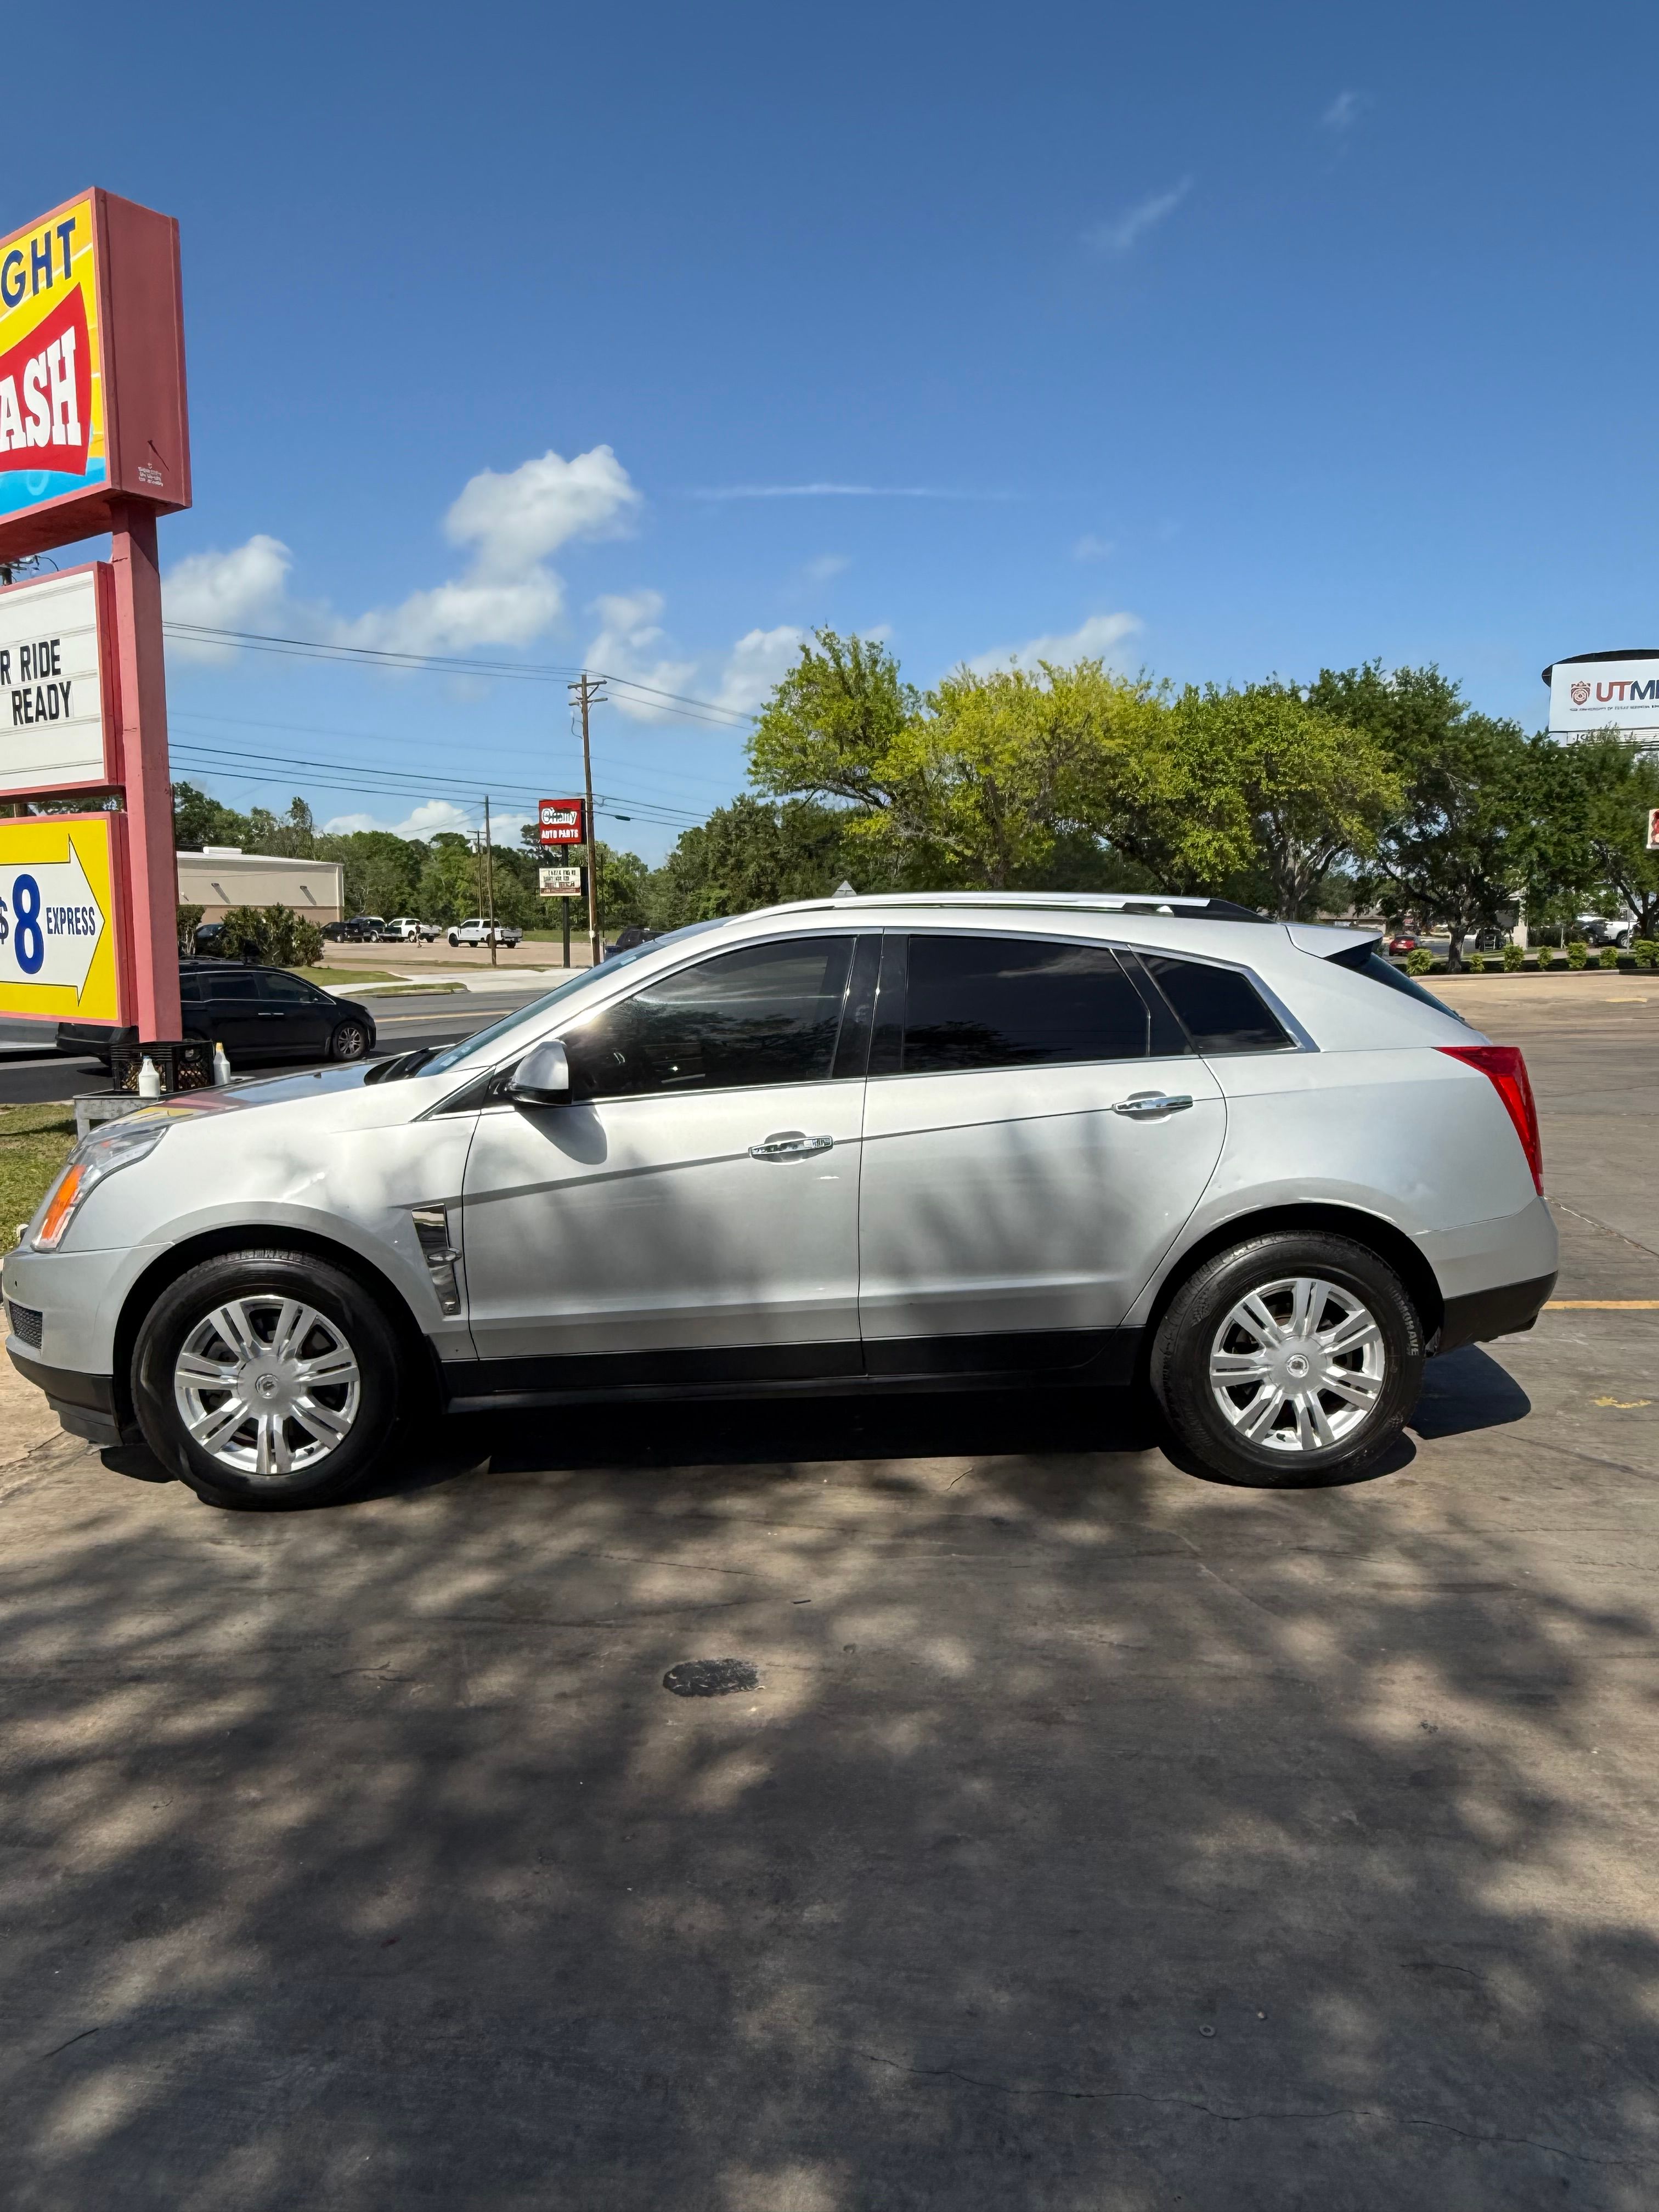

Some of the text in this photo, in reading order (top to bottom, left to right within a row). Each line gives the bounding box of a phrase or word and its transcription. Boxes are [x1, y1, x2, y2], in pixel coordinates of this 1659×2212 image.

[1, 217, 76, 308] GHT
[0, 326, 82, 453] ASH
[0, 638, 61, 685] R RIDE
[12, 681, 72, 726] READY
[1596, 679, 1659, 702] UTM
[541, 829, 579, 839] AUTO PARTS
[46, 906, 96, 935] EXPRESS
